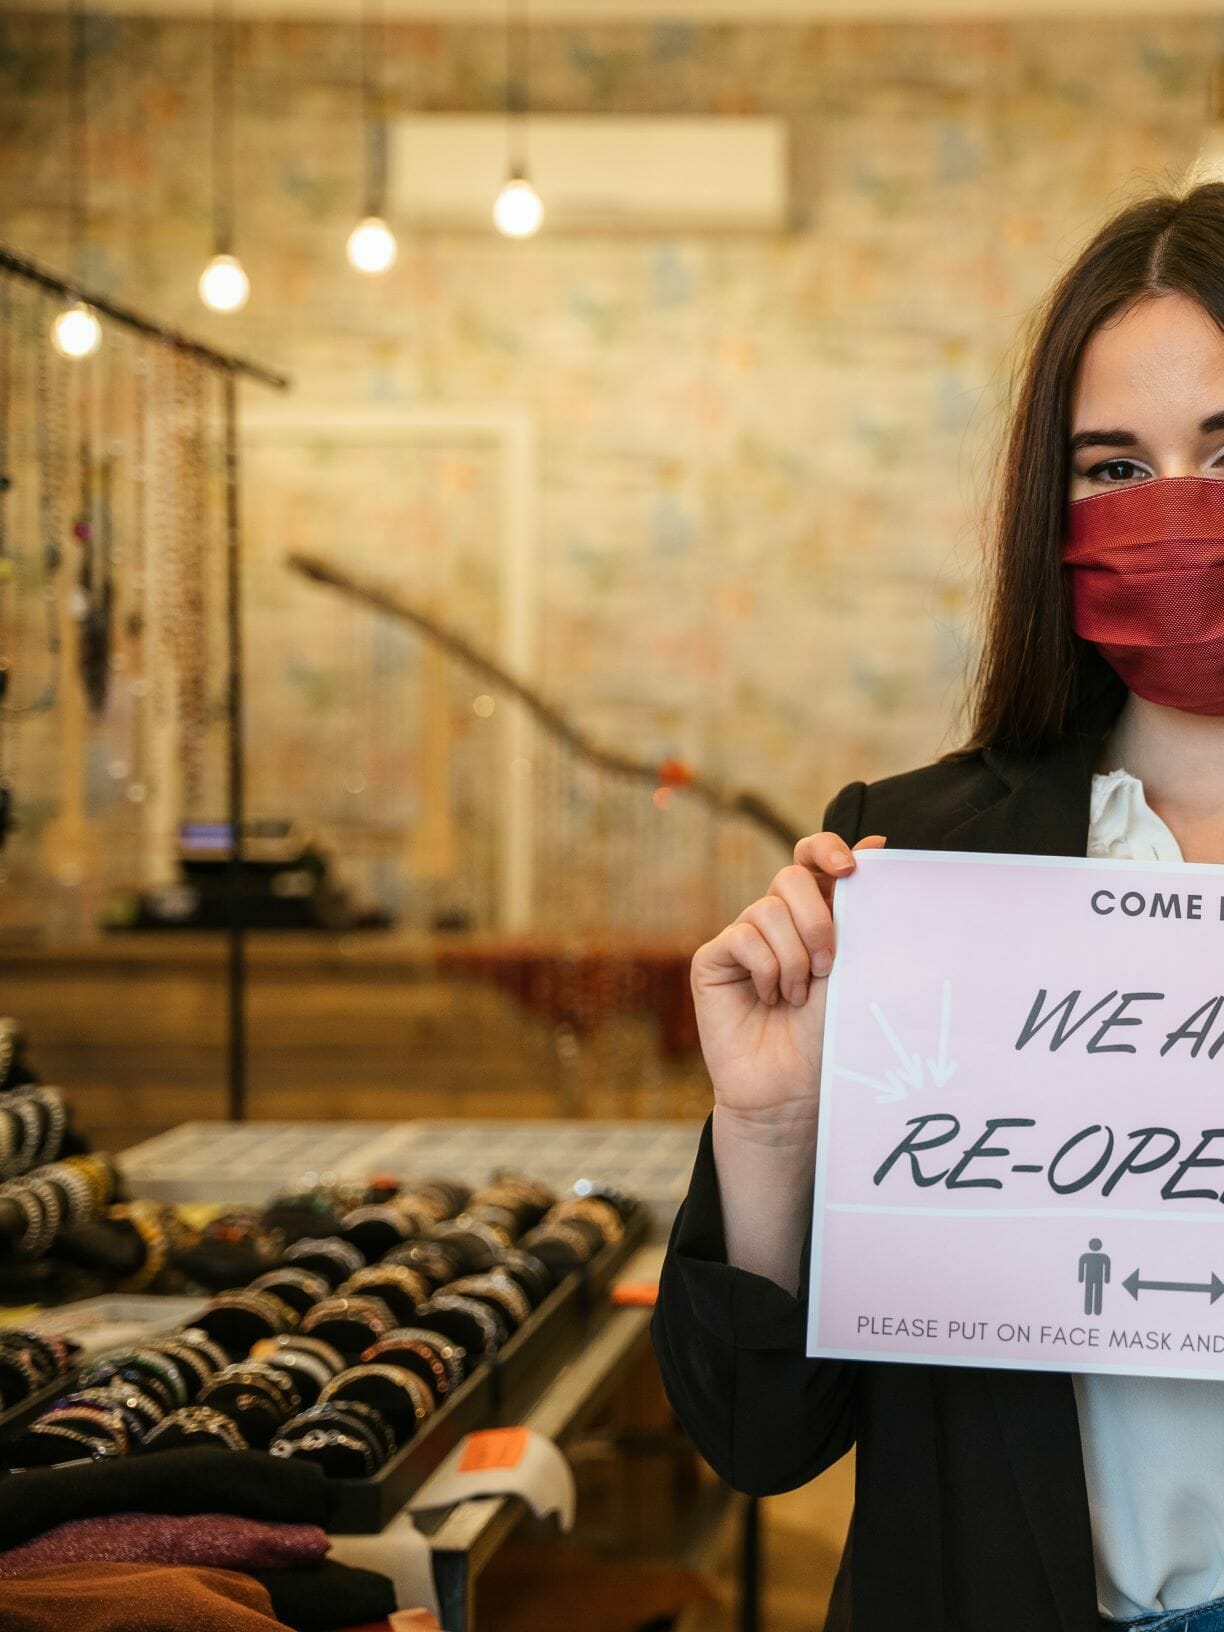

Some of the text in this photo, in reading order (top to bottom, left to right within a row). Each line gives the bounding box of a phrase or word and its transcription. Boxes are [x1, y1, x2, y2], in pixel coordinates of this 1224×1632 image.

[1090, 889, 1203, 920] COME
[1014, 988, 1165, 1054] WE
[857, 1315, 938, 1338] PLEASE
[948, 1321, 989, 1341] PUT
[997, 1324, 1031, 1343] ON
[1040, 1326, 1099, 1347] FACE
[1108, 1330, 1171, 1350] MASK
